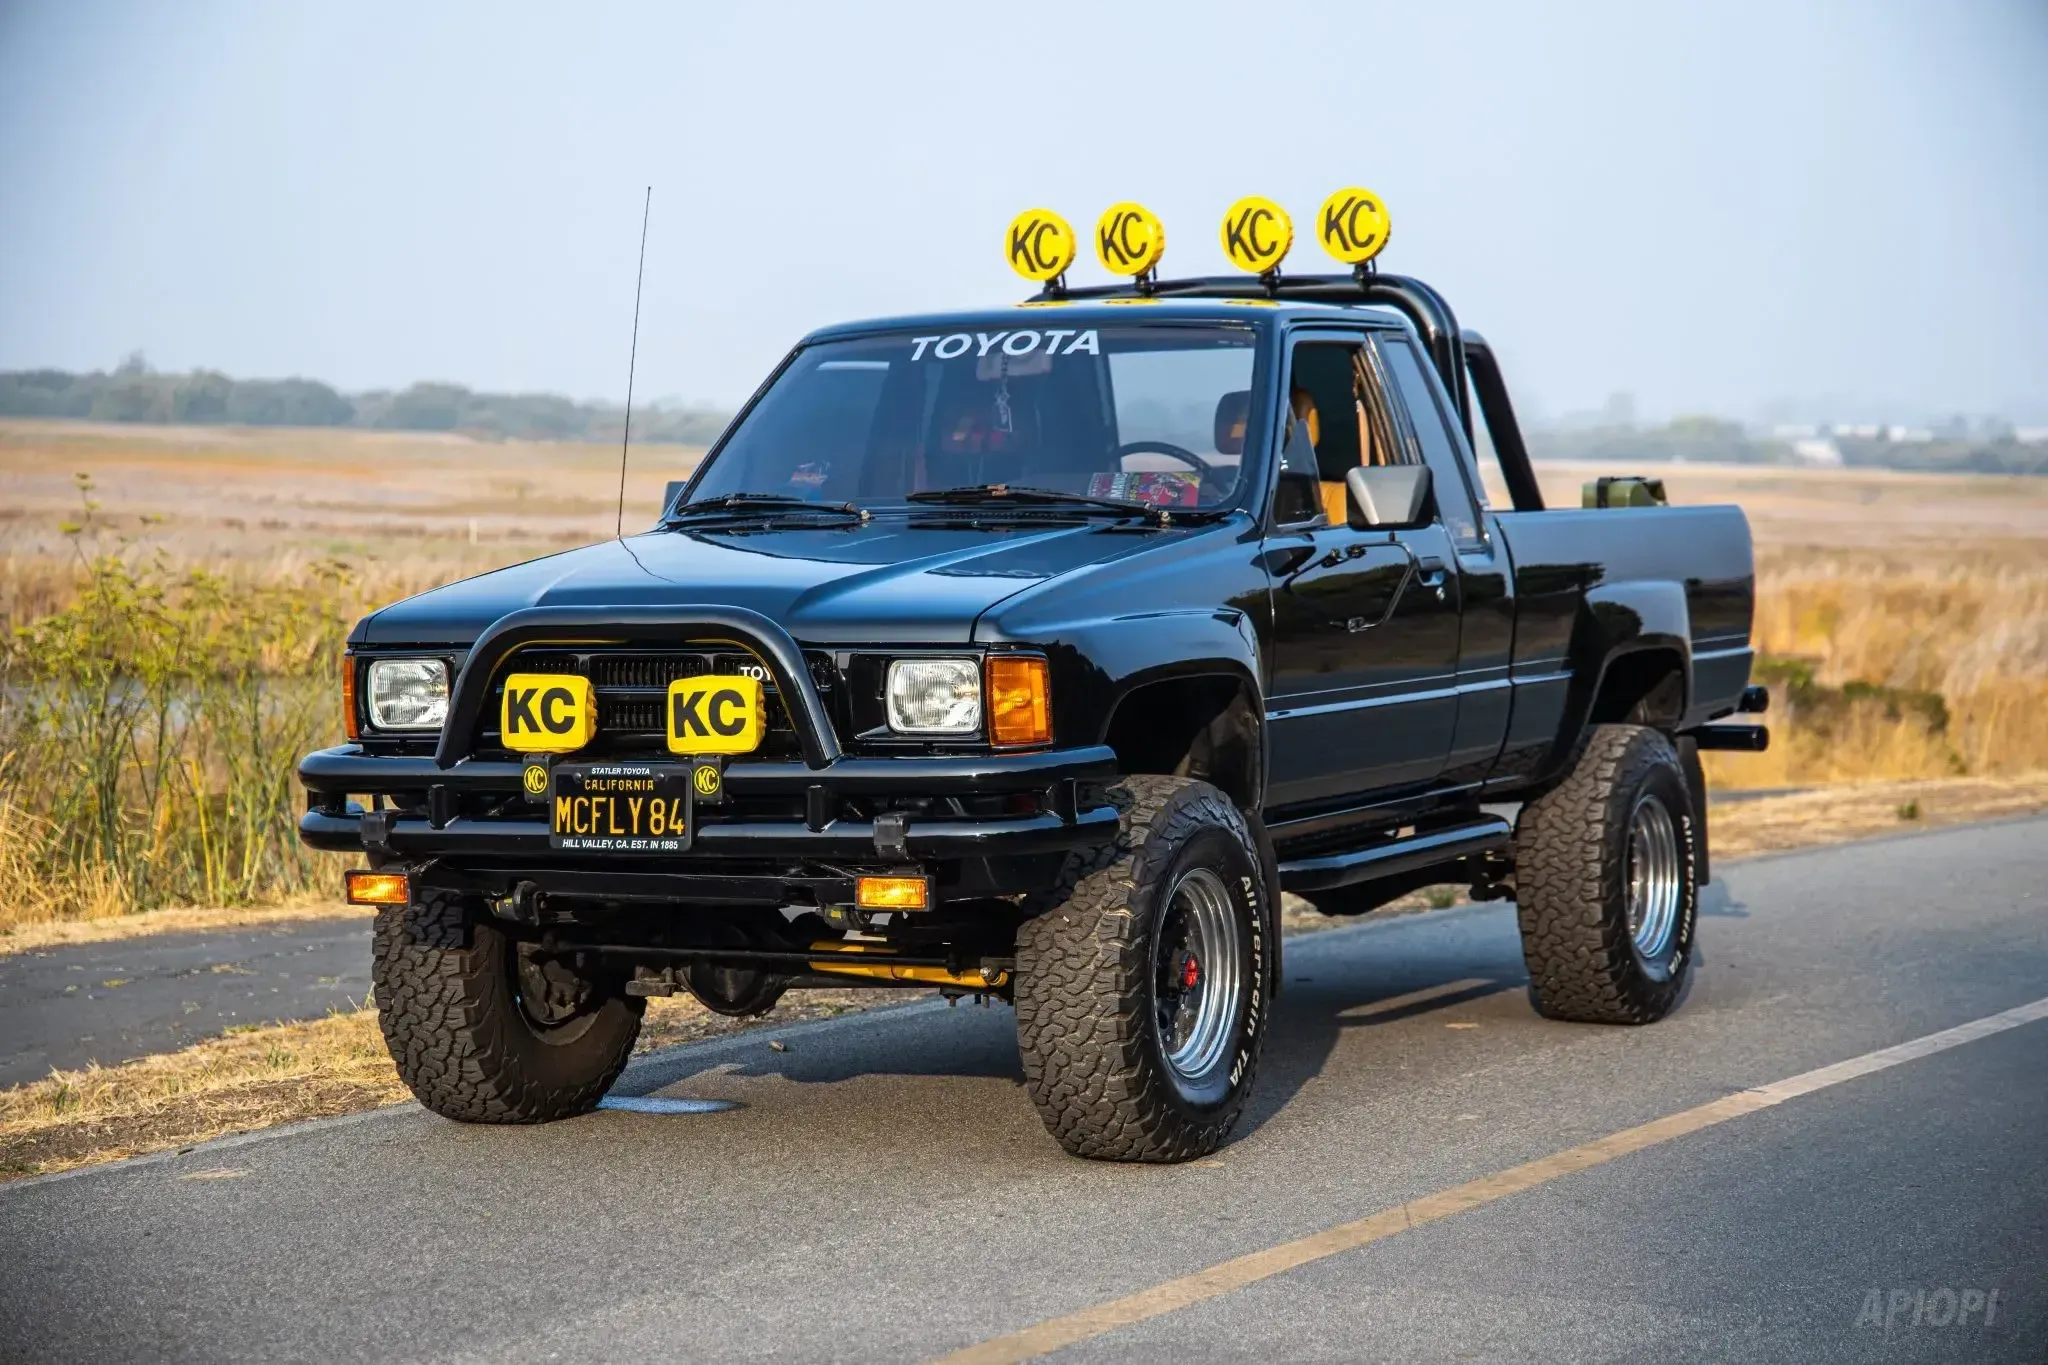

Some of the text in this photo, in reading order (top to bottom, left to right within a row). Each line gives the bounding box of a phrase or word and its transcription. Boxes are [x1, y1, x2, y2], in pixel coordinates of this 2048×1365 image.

[1101, 211, 1148, 266] KC
[1227, 207, 1277, 262] KC
[1325, 196, 1376, 252] KC
[1012, 218, 1059, 273] KC
[911, 330, 1100, 362] TOYOTA
[507, 687, 576, 735] KC
[673, 689, 747, 739] KC
[526, 769, 544, 792] KC
[584, 779, 654, 791] CALIFORNIA
[591, 767, 622, 775] STATLER
[697, 767, 717, 792] KC
[562, 839, 678, 850] HILL VALLEY, CA. EST. IN 1885
